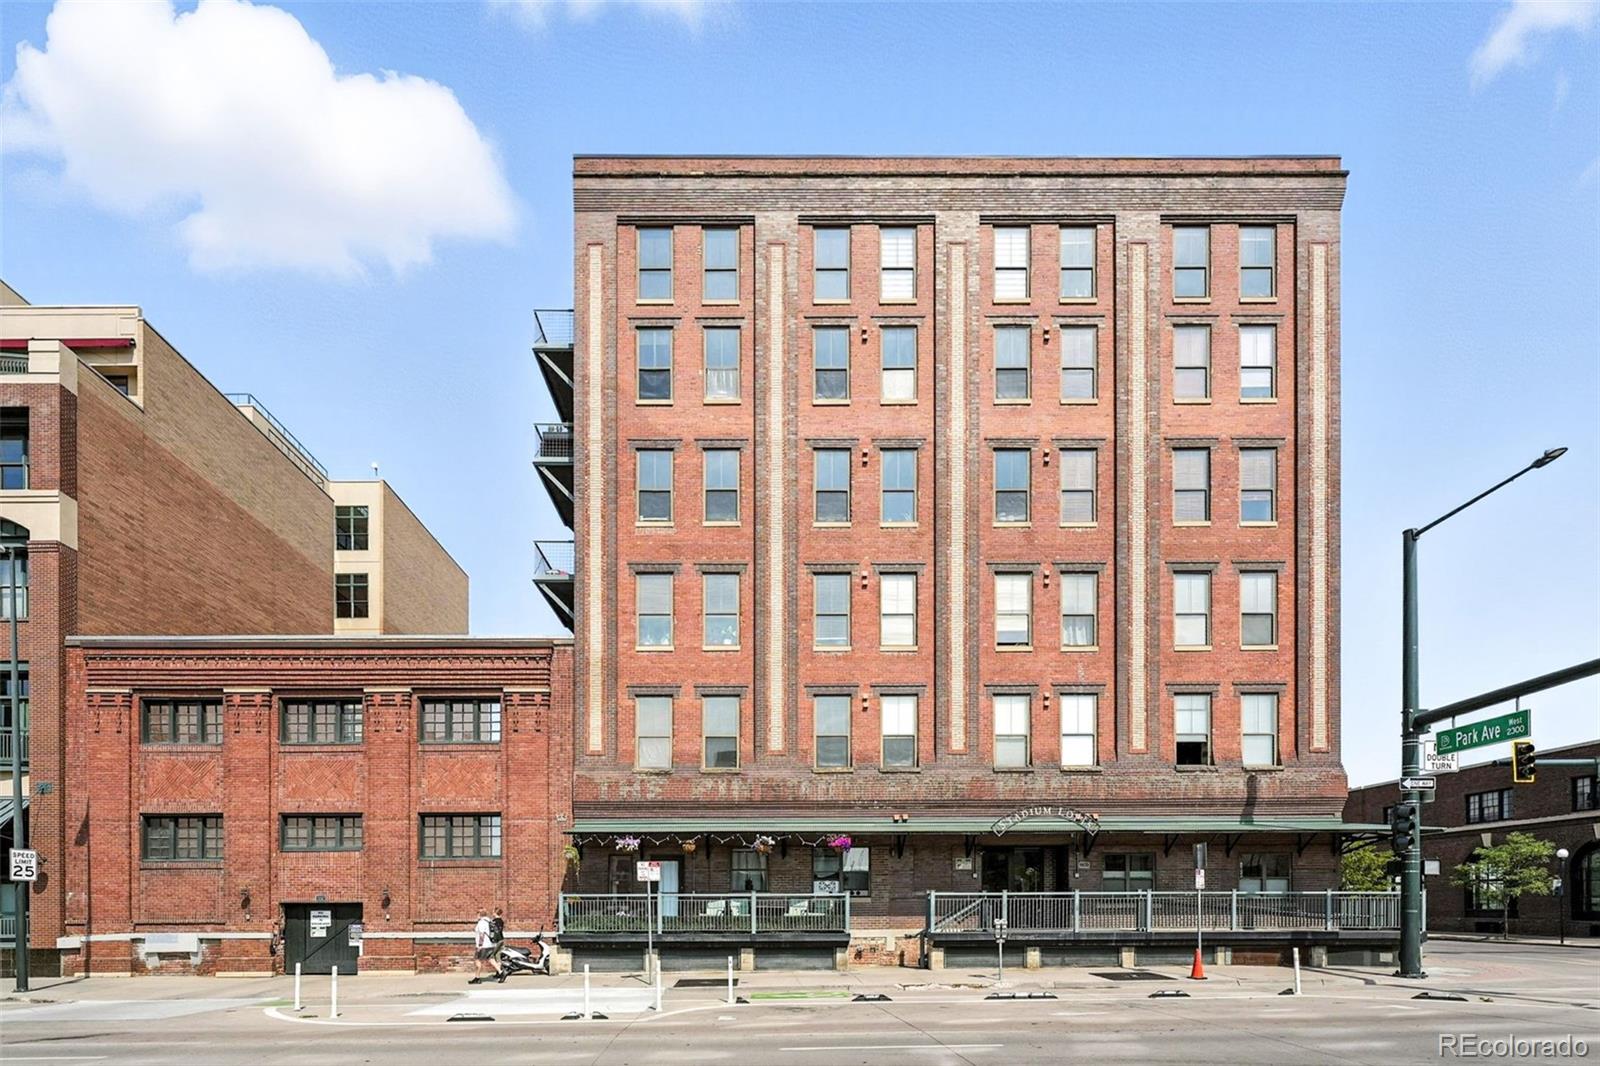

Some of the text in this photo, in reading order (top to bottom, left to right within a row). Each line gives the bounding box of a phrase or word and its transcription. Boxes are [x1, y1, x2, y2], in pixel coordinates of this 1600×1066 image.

[1508, 716, 1523, 726] West
[1455, 725, 1501, 747] Park Ave
[1506, 725, 1525, 736] 2300
[1426, 753, 1455, 762] DOUBLE
[1431, 762, 1452, 770] TURN
[1000, 806, 1052, 830] STADIUM
[13, 865, 35, 877] 25
